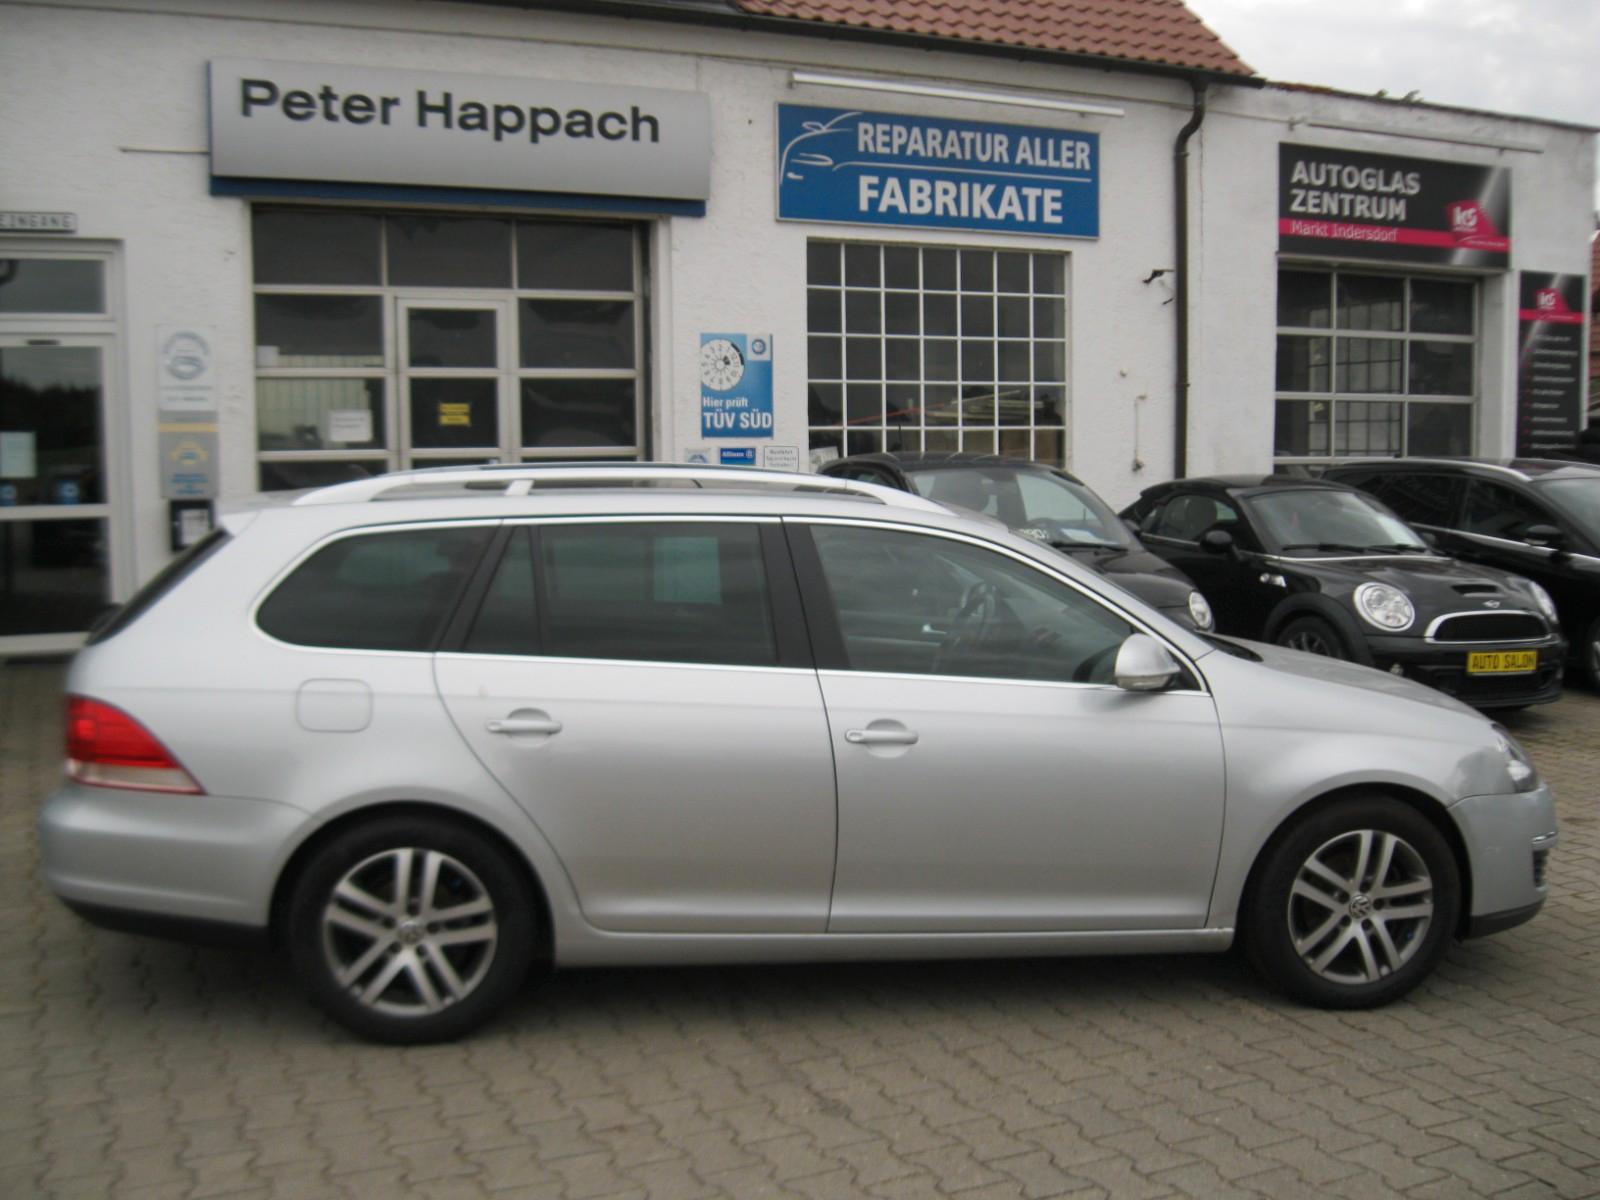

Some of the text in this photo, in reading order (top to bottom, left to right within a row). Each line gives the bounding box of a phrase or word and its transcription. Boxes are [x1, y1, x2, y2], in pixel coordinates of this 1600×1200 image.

[240, 78, 660, 145] Peter Happach
[857, 122, 1091, 171] REPARATUR ALLER
[1290, 160, 1421, 196] AUTOGLAS
[858, 175, 1064, 224] FABRIKATE
[1289, 188, 1407, 221] ZENTRUM
[1290, 220, 1399, 242] Markt Indersdorf
[703, 396, 723, 407] Hier
[703, 408, 772, 430] TÜV SÜD
[1472, 655, 1499, 669] AUTO
